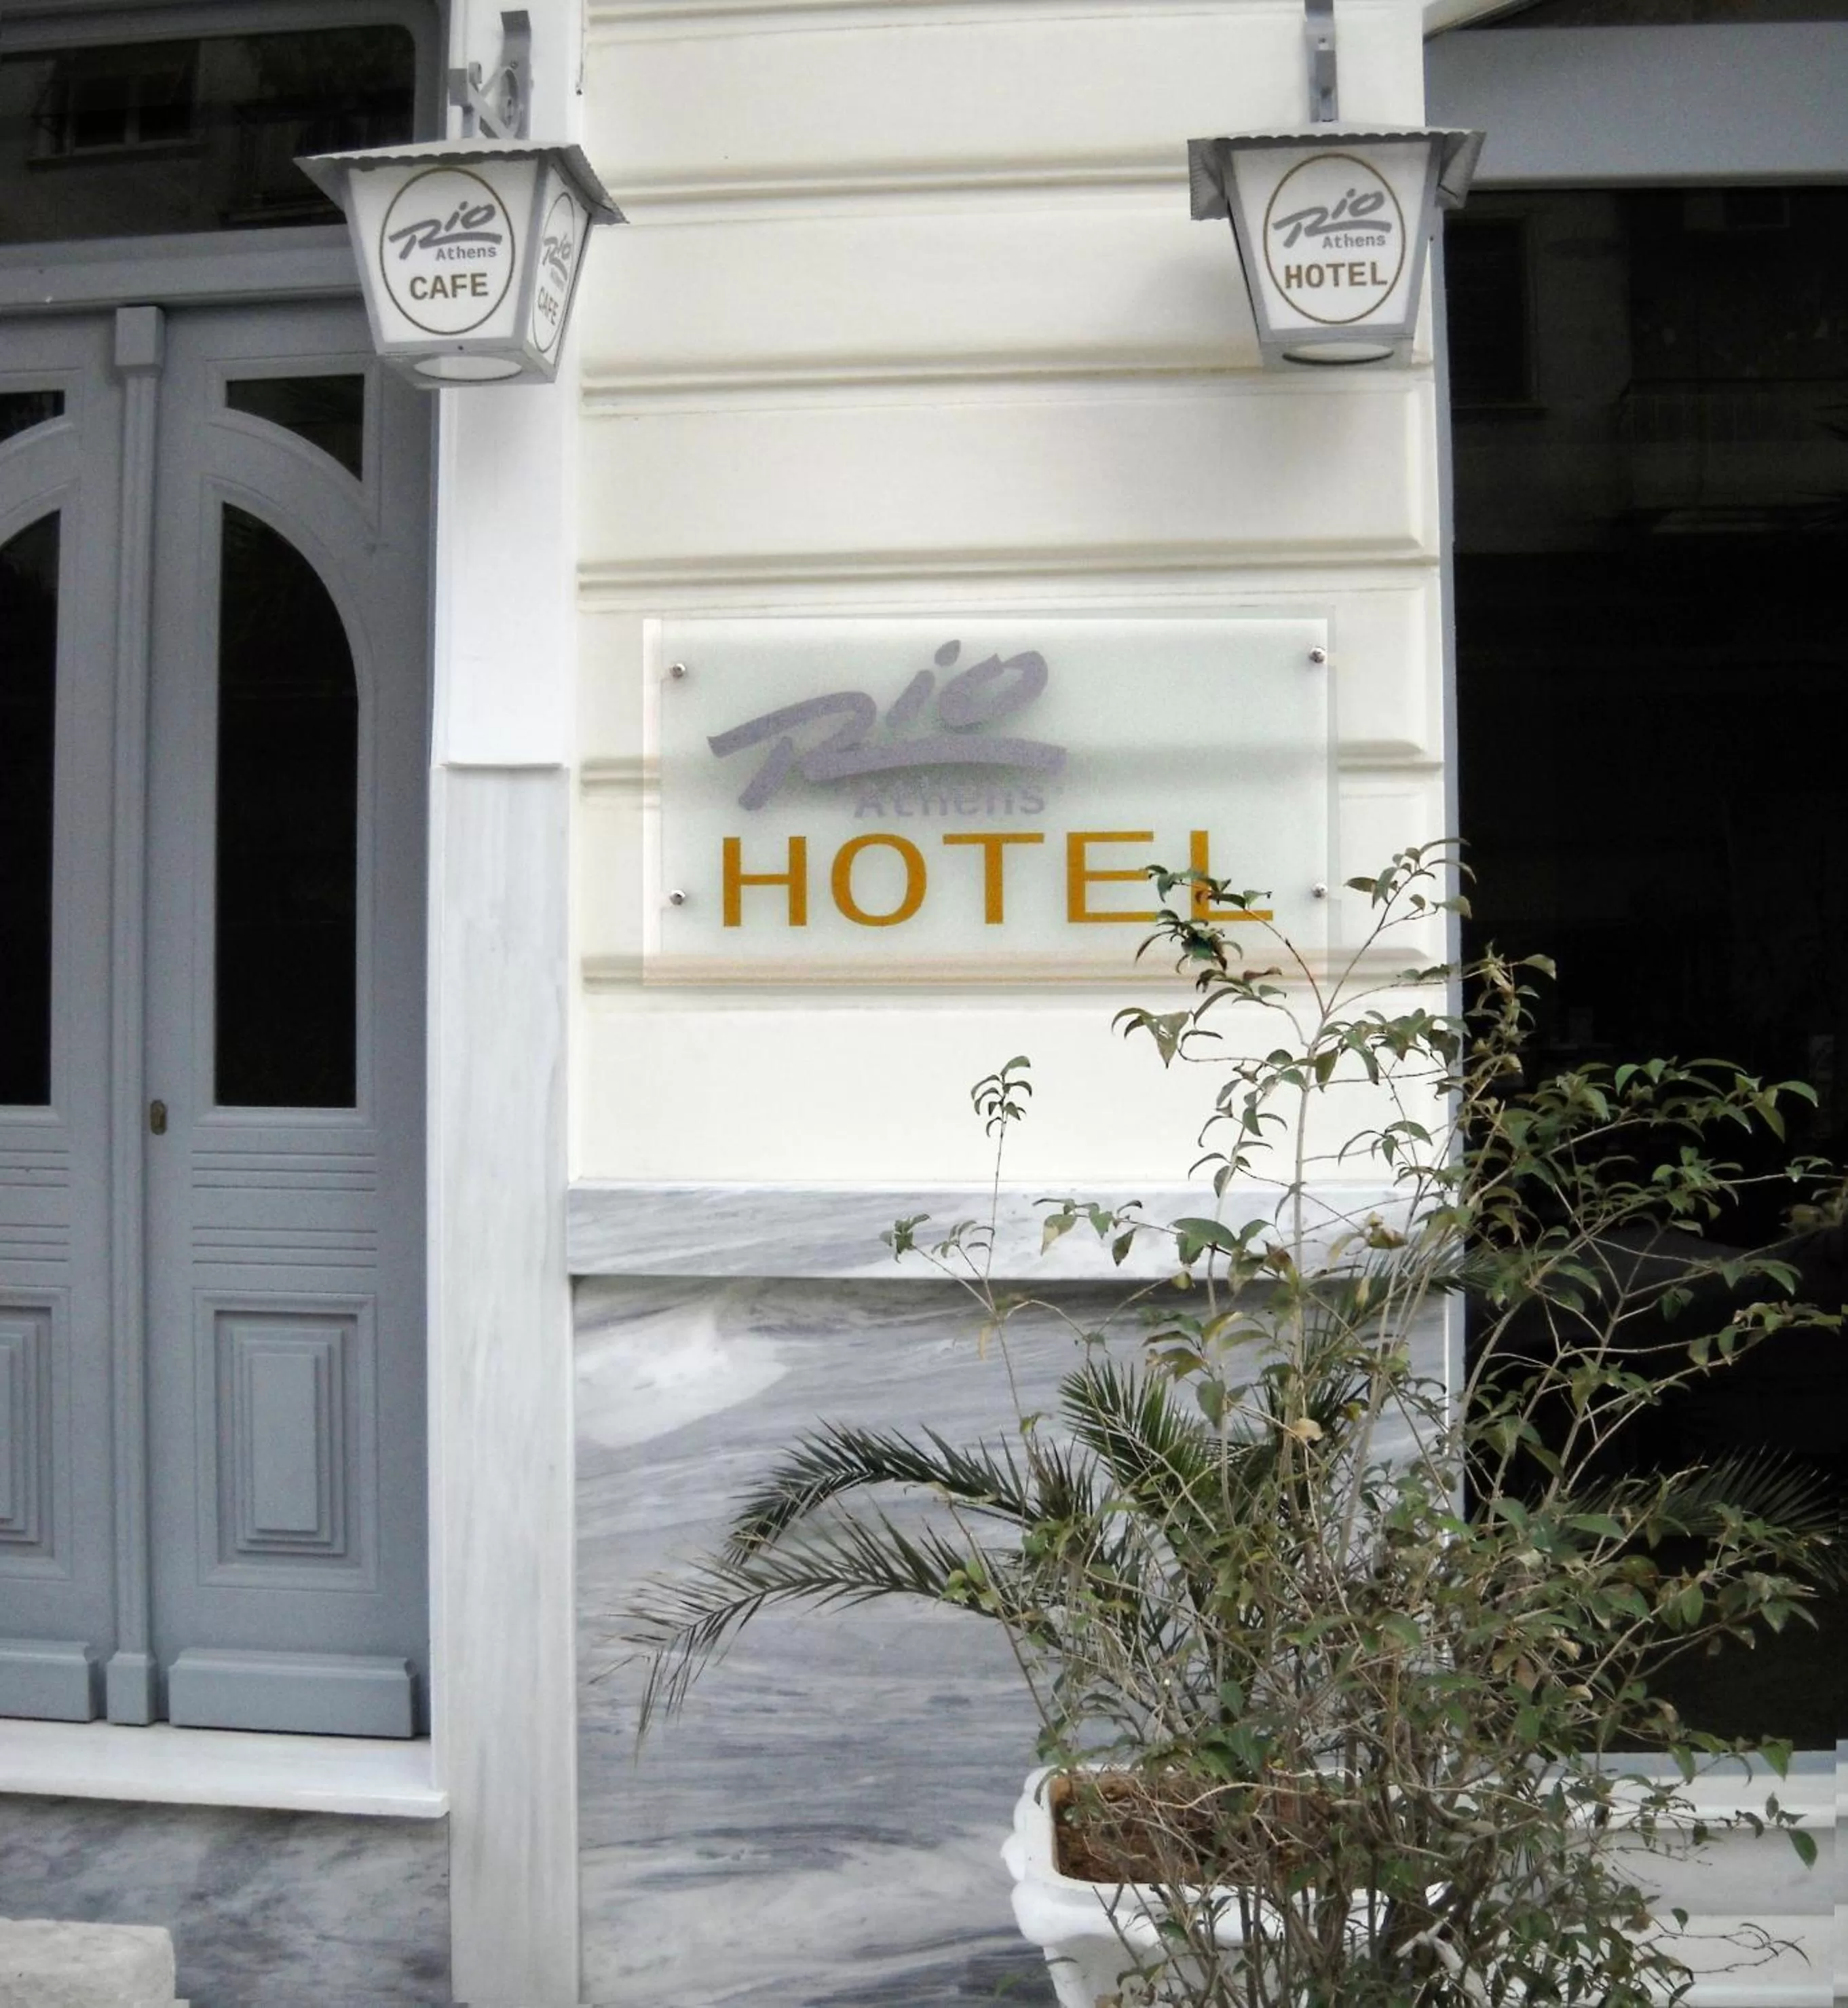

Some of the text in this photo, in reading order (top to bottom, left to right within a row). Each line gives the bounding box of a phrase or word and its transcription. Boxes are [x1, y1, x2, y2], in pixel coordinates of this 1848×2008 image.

[388, 201, 503, 260] Rio
[1272, 187, 1393, 248] Rio
[435, 245, 497, 261] Athens
[1322, 234, 1386, 248] Athens
[409, 273, 489, 300] CAFE
[1284, 261, 1388, 289] HOTEL
[706, 639, 1068, 811] Rio
[853, 776, 1046, 818] Athens
[723, 830, 1274, 928] HOTEL
